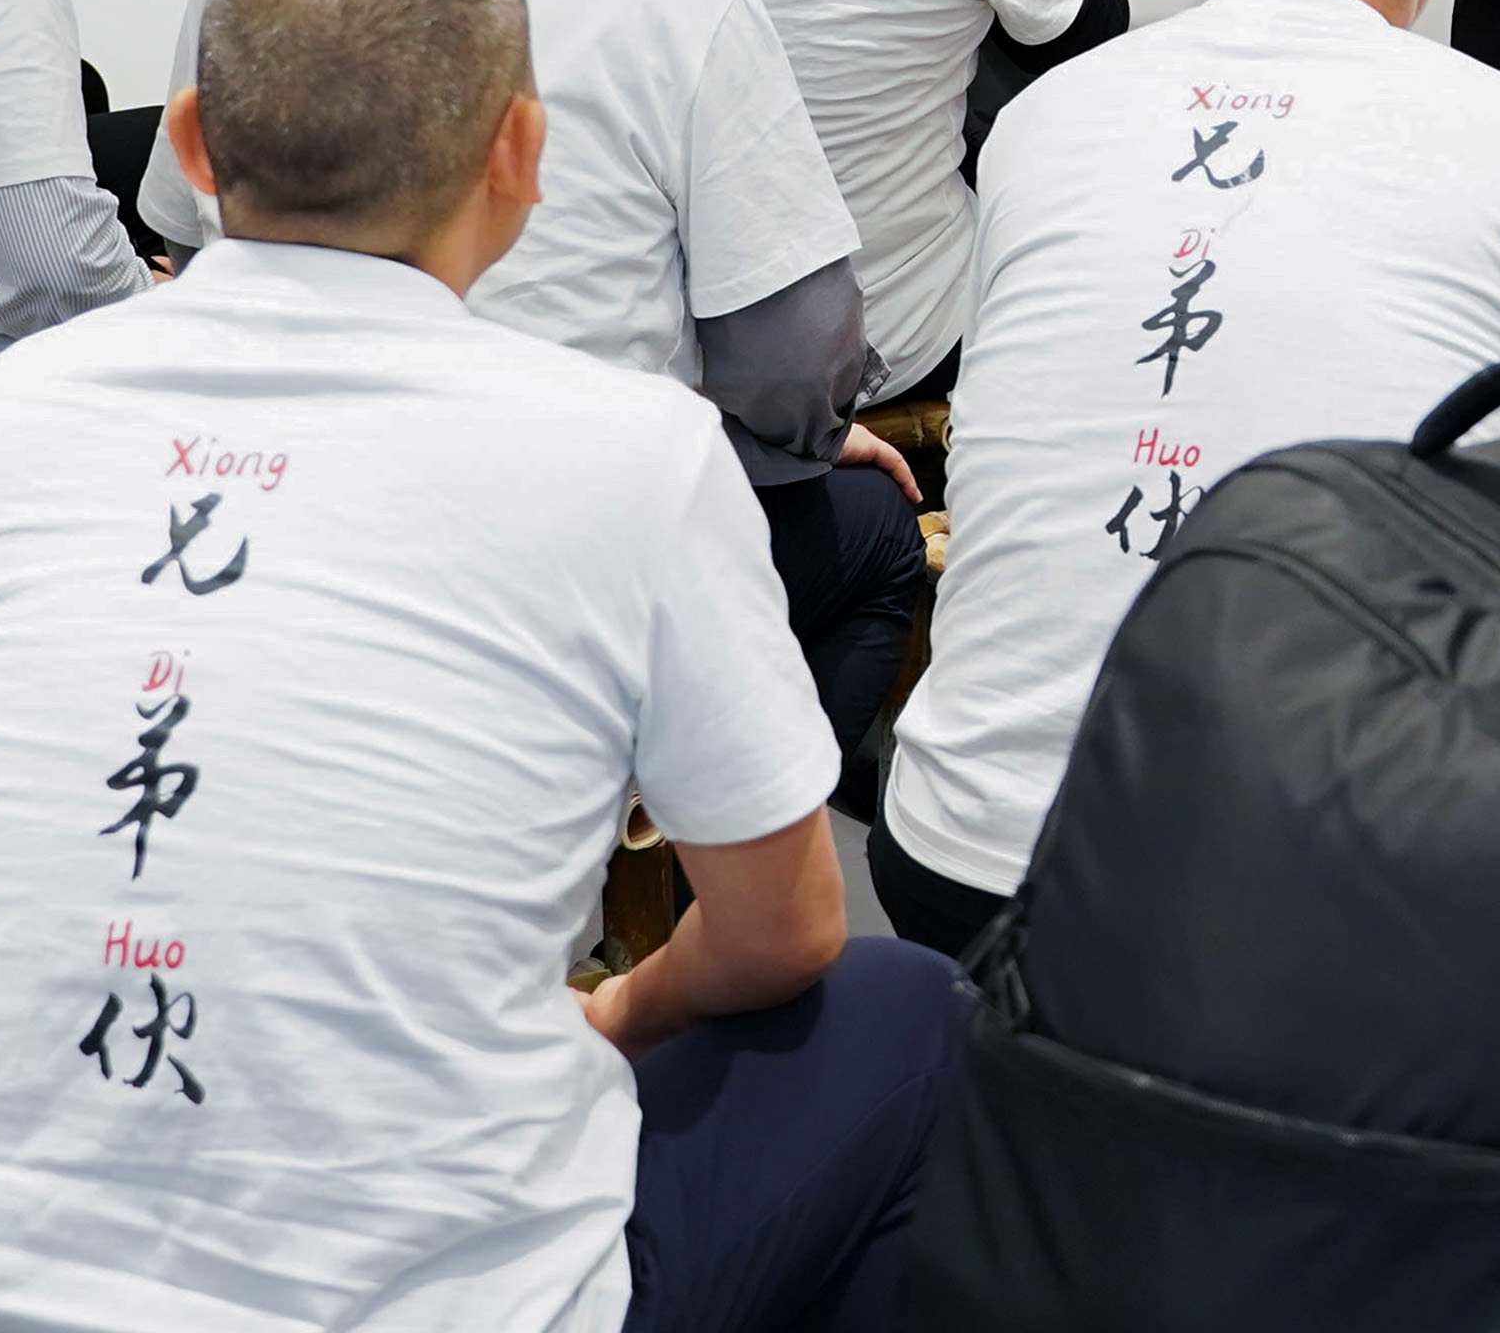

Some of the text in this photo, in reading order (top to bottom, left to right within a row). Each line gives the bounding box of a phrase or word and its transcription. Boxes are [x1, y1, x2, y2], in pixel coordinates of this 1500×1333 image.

[1187, 84, 1296, 119] Xiong
[1171, 120, 1265, 189] 兄
[1172, 228, 1216, 260] Di
[1135, 259, 1224, 398] 弟
[165, 437, 289, 494] Xiong
[1133, 429, 1201, 467] Huo
[140, 491, 250, 596] 兄
[141, 649, 192, 695] Di
[98, 693, 200, 882] 弟
[103, 920, 187, 970] Huo
